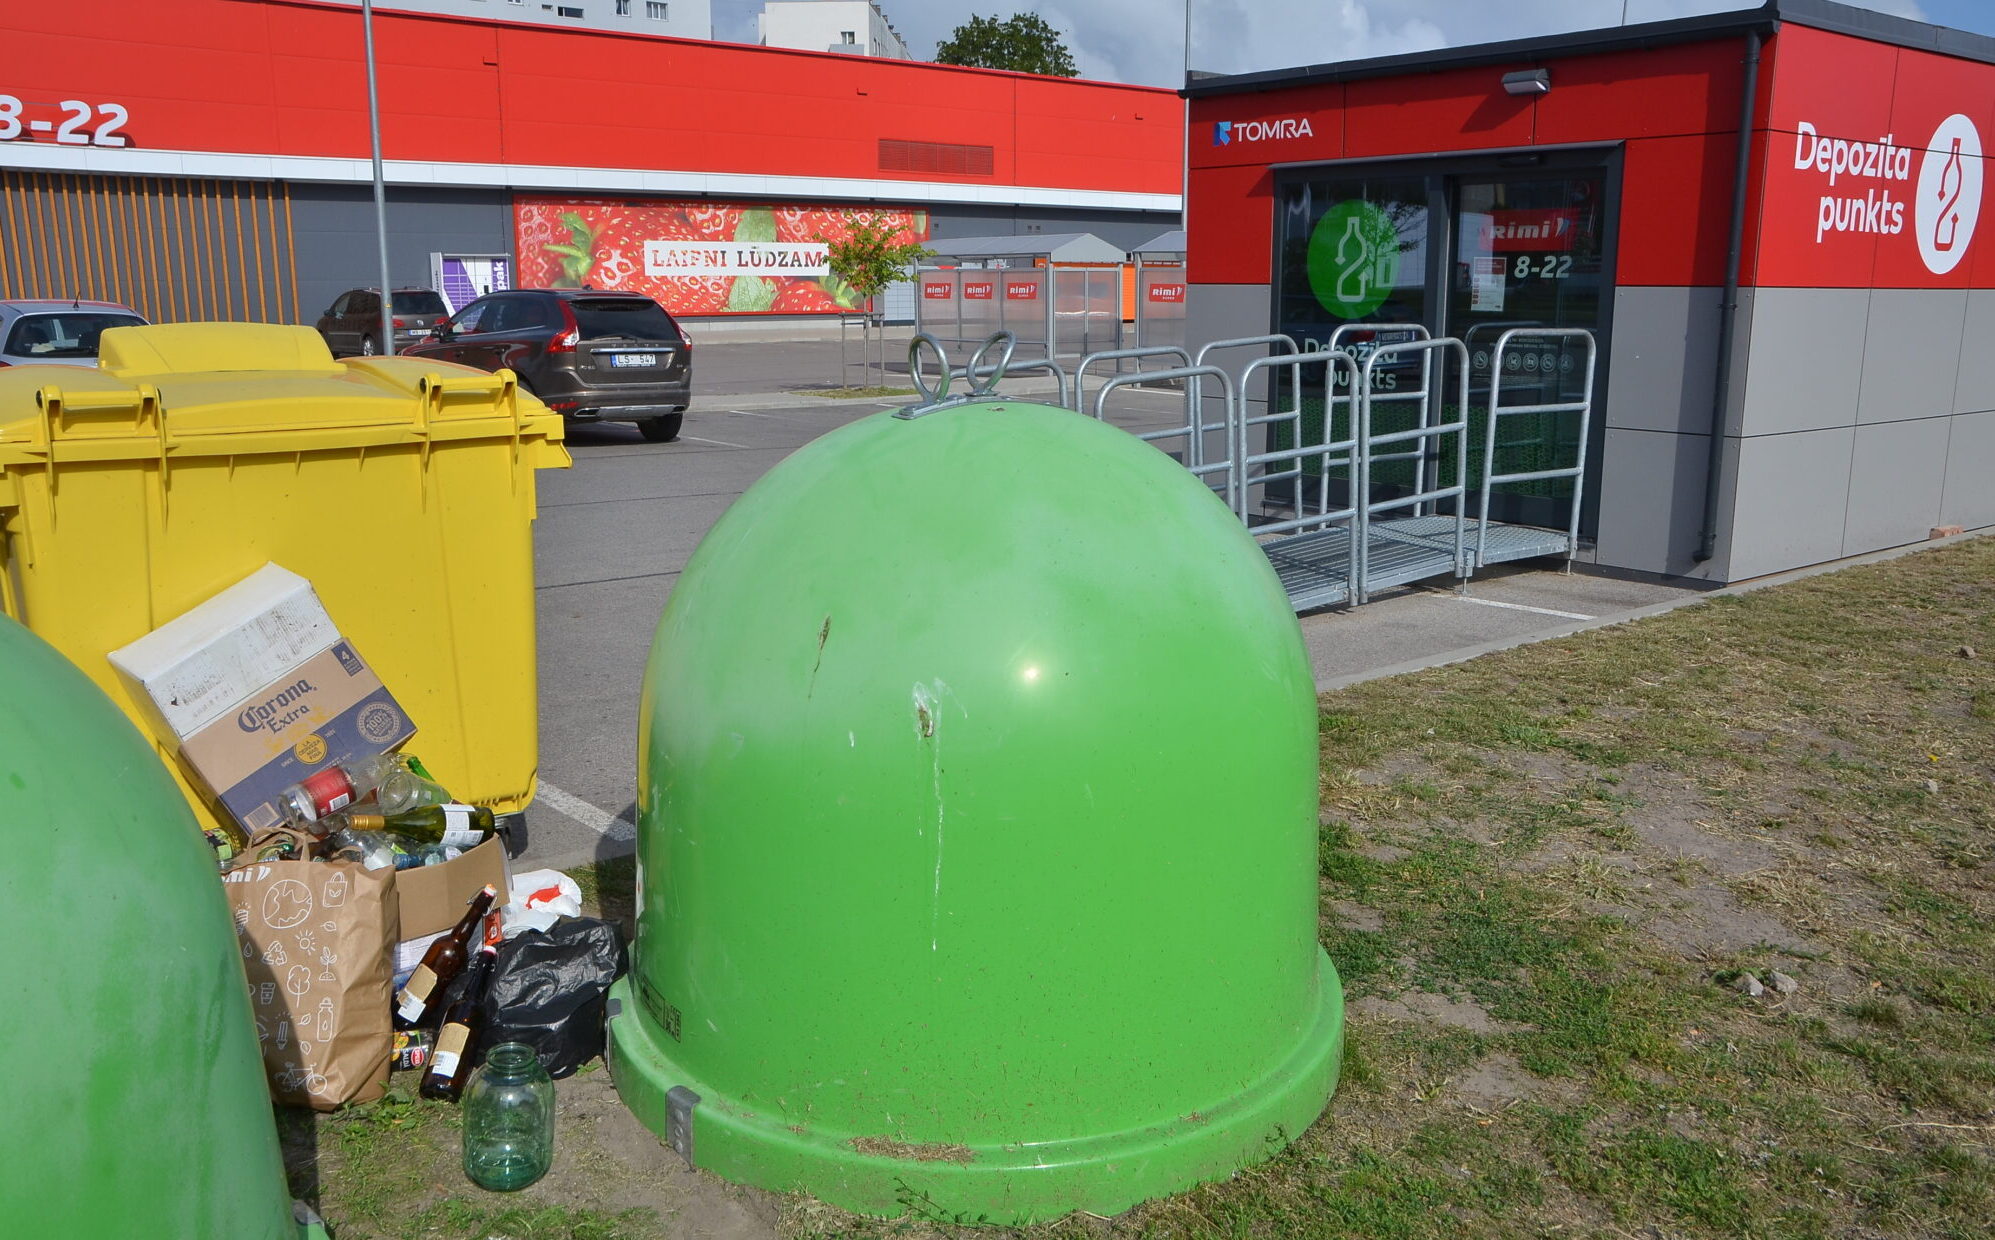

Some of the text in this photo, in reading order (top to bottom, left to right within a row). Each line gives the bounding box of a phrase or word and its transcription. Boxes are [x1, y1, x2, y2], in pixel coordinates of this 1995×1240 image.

[0, 94, 128, 147] 8-22
[1233, 118, 1314, 142] TOMRA
[1794, 121, 1911, 186] Depozīta
[1816, 188, 1905, 243] punkts
[1514, 255, 1573, 279] 8-22
[237, 678, 314, 733] Corona
[267, 704, 311, 734] Extra
